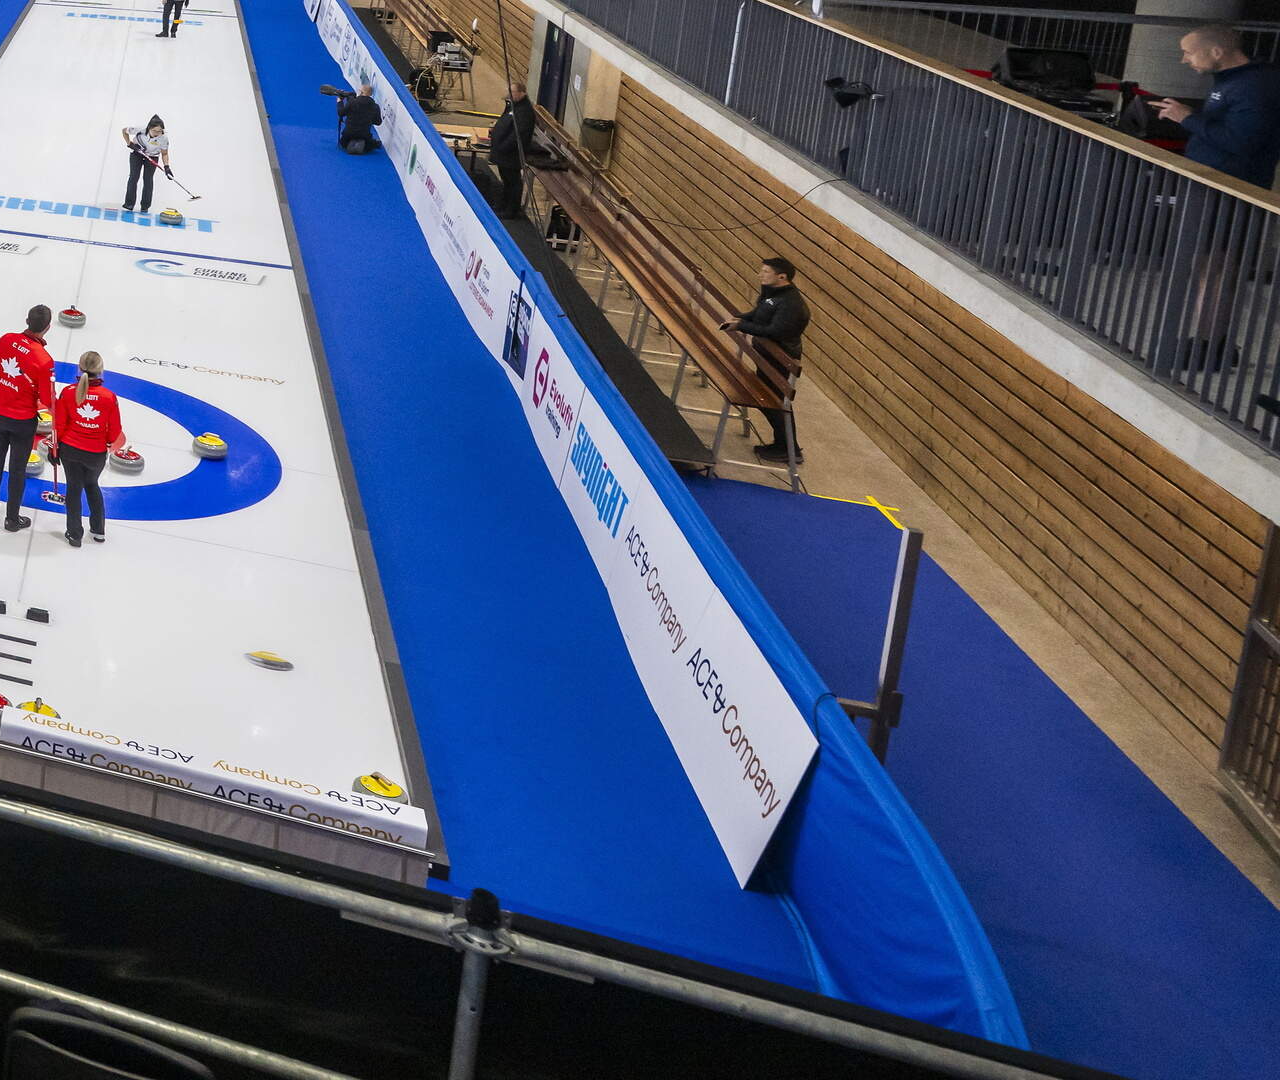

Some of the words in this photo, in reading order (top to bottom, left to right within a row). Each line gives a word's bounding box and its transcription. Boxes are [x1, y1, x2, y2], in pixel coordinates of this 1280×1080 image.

[193, 271, 249, 283] CHANNEL
[194, 266, 247, 279] CURLING
[129, 355, 172, 368] ACE
[192, 364, 288, 386] Company
[546, 402, 562, 440] training
[549, 377, 574, 432] Evolufit
[625, 525, 644, 565] ACE
[646, 567, 687, 655] Company
[23, 712, 121, 747] Company
[686, 647, 715, 700] ACE
[721, 704, 781, 819] Company
[21, 735, 65, 757] ACE
[90, 752, 193, 791] Company
[146, 744, 195, 764] ACE
[212, 759, 322, 796] Company
[212, 784, 261, 809] ACE
[288, 803, 404, 844] Company
[350, 794, 401, 816] ACE
